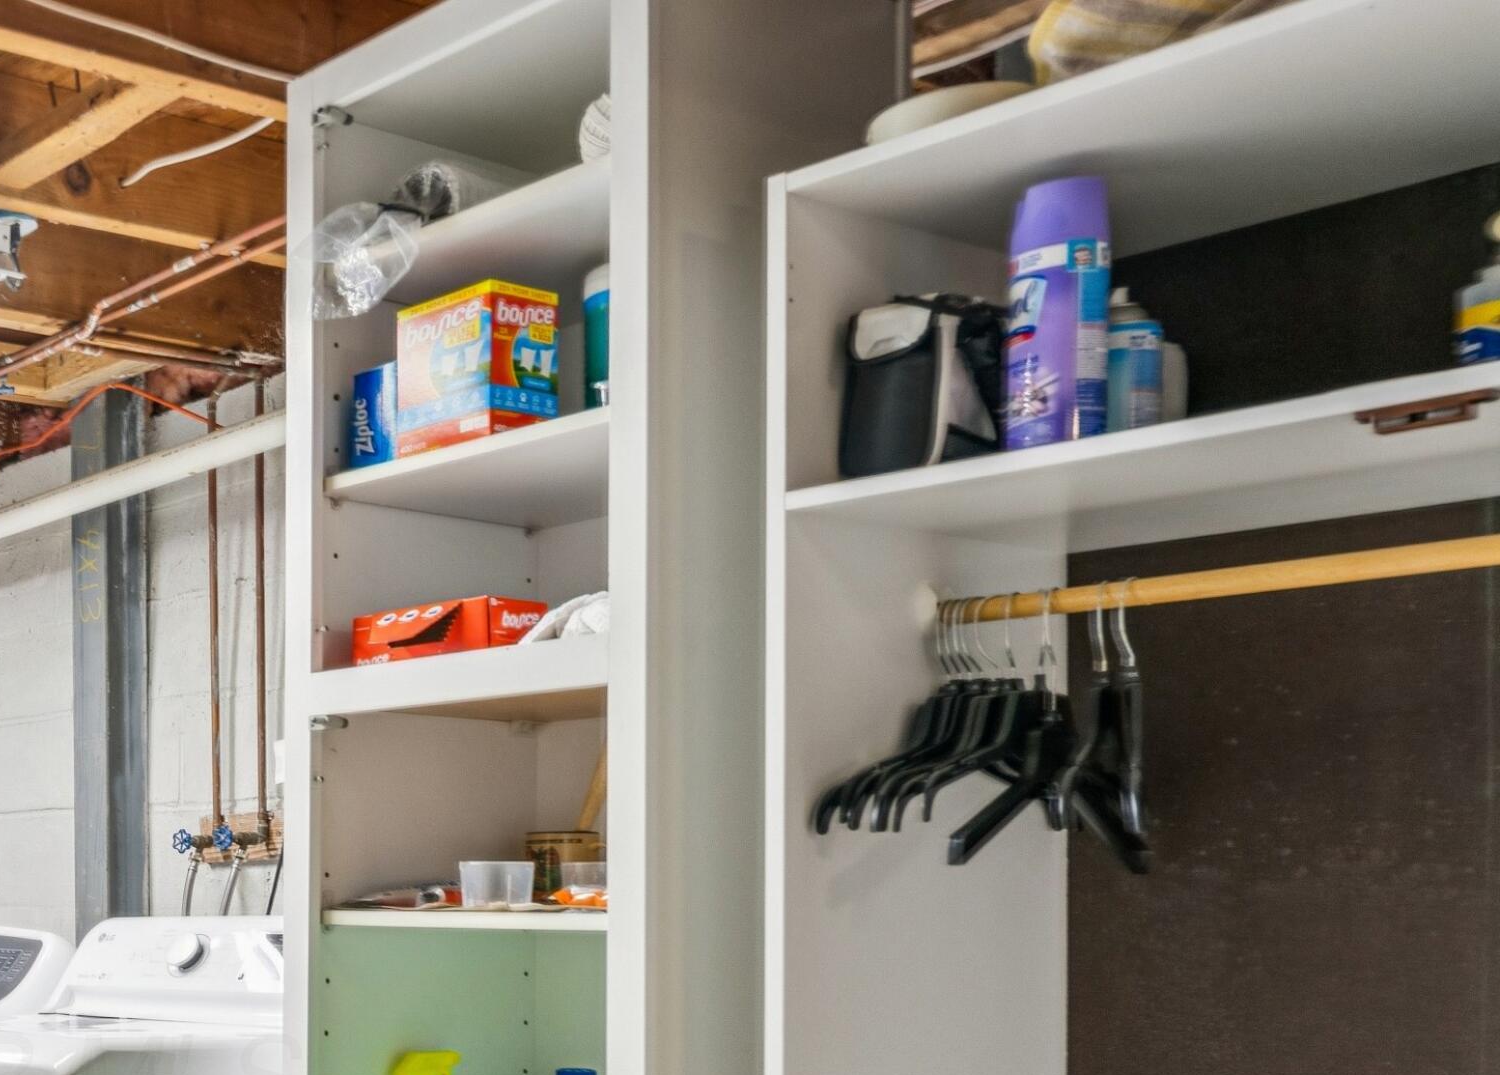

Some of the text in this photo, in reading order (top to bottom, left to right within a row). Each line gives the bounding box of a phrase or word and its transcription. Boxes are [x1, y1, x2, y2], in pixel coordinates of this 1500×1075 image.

[405, 300, 481, 347] bounce
[497, 300, 555, 326] bounce
[355, 398, 375, 457] Ziploc
[501, 611, 541, 628] bounce
